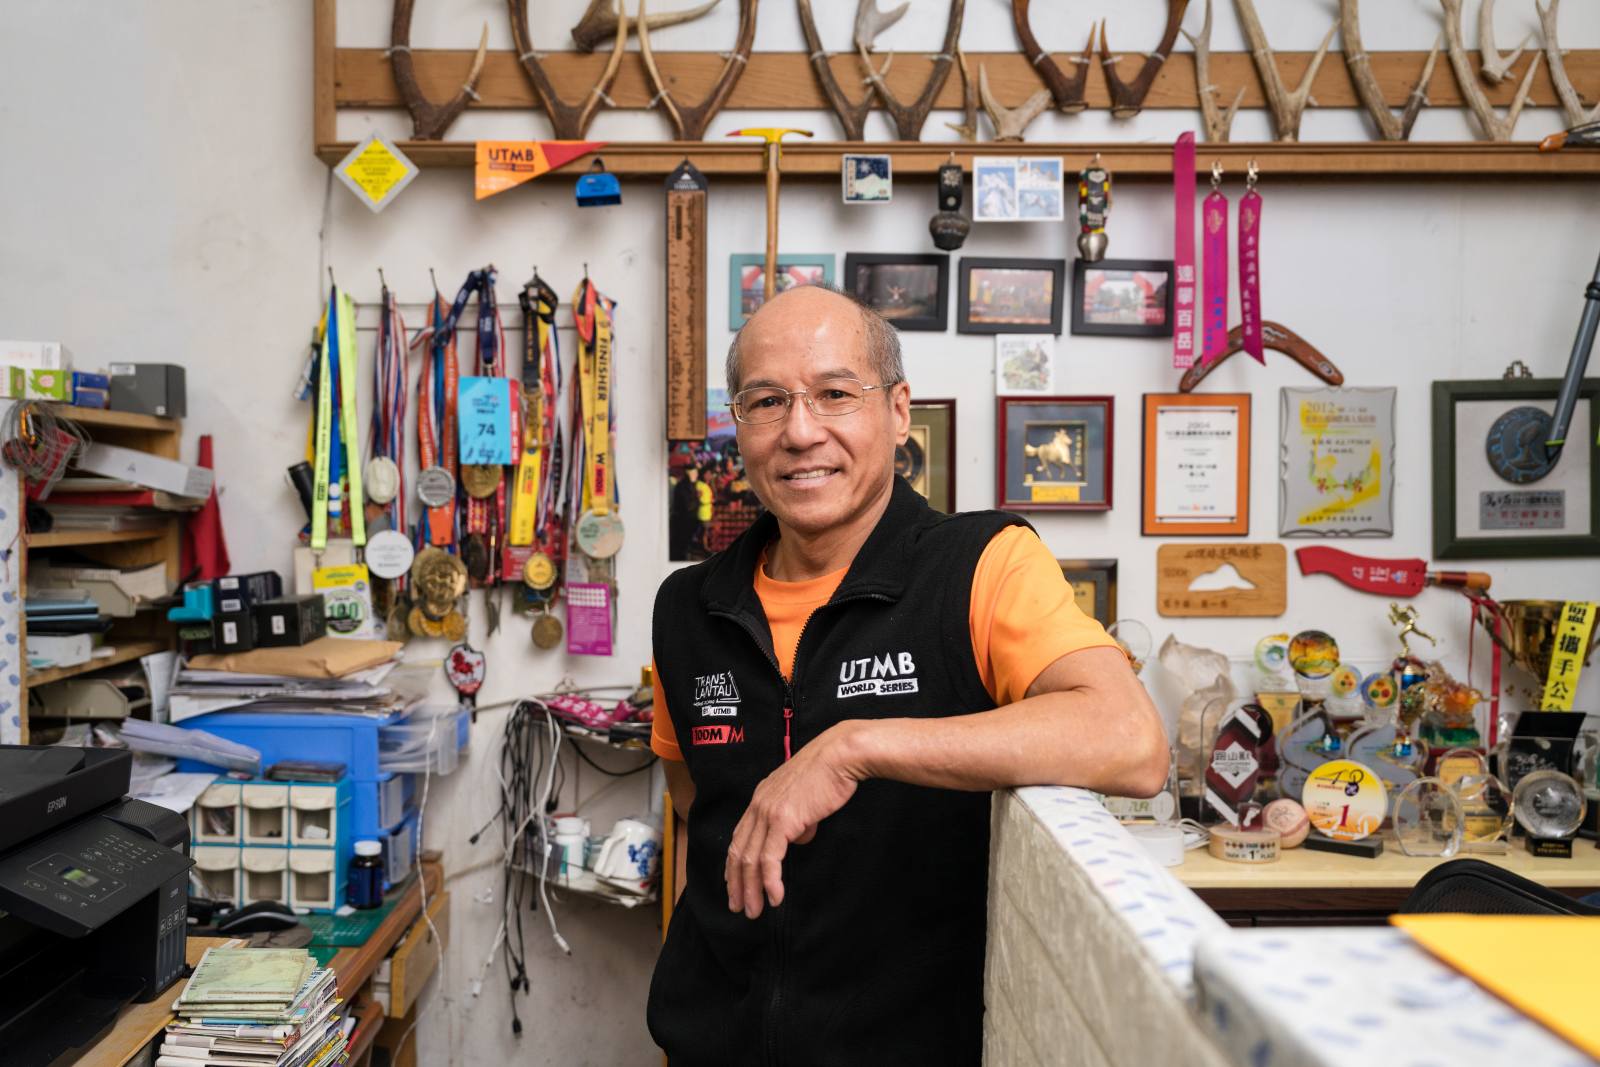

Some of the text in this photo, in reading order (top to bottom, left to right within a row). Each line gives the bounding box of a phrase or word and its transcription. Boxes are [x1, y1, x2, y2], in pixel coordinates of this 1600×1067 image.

[488, 148, 534, 161] UTMB
[598, 337, 609, 401] FINISHER
[478, 423, 496, 436] 74
[839, 651, 915, 683] UTMB
[695, 672, 726, 688] TRANS
[695, 684, 732, 700] LANTAU
[841, 681, 915, 696] WORLD SERIES
[713, 707, 732, 715] UTMB
[694, 727, 723, 741] 100M
[47, 796, 67, 813] EPSON
[1340, 804, 1350, 827] 1
